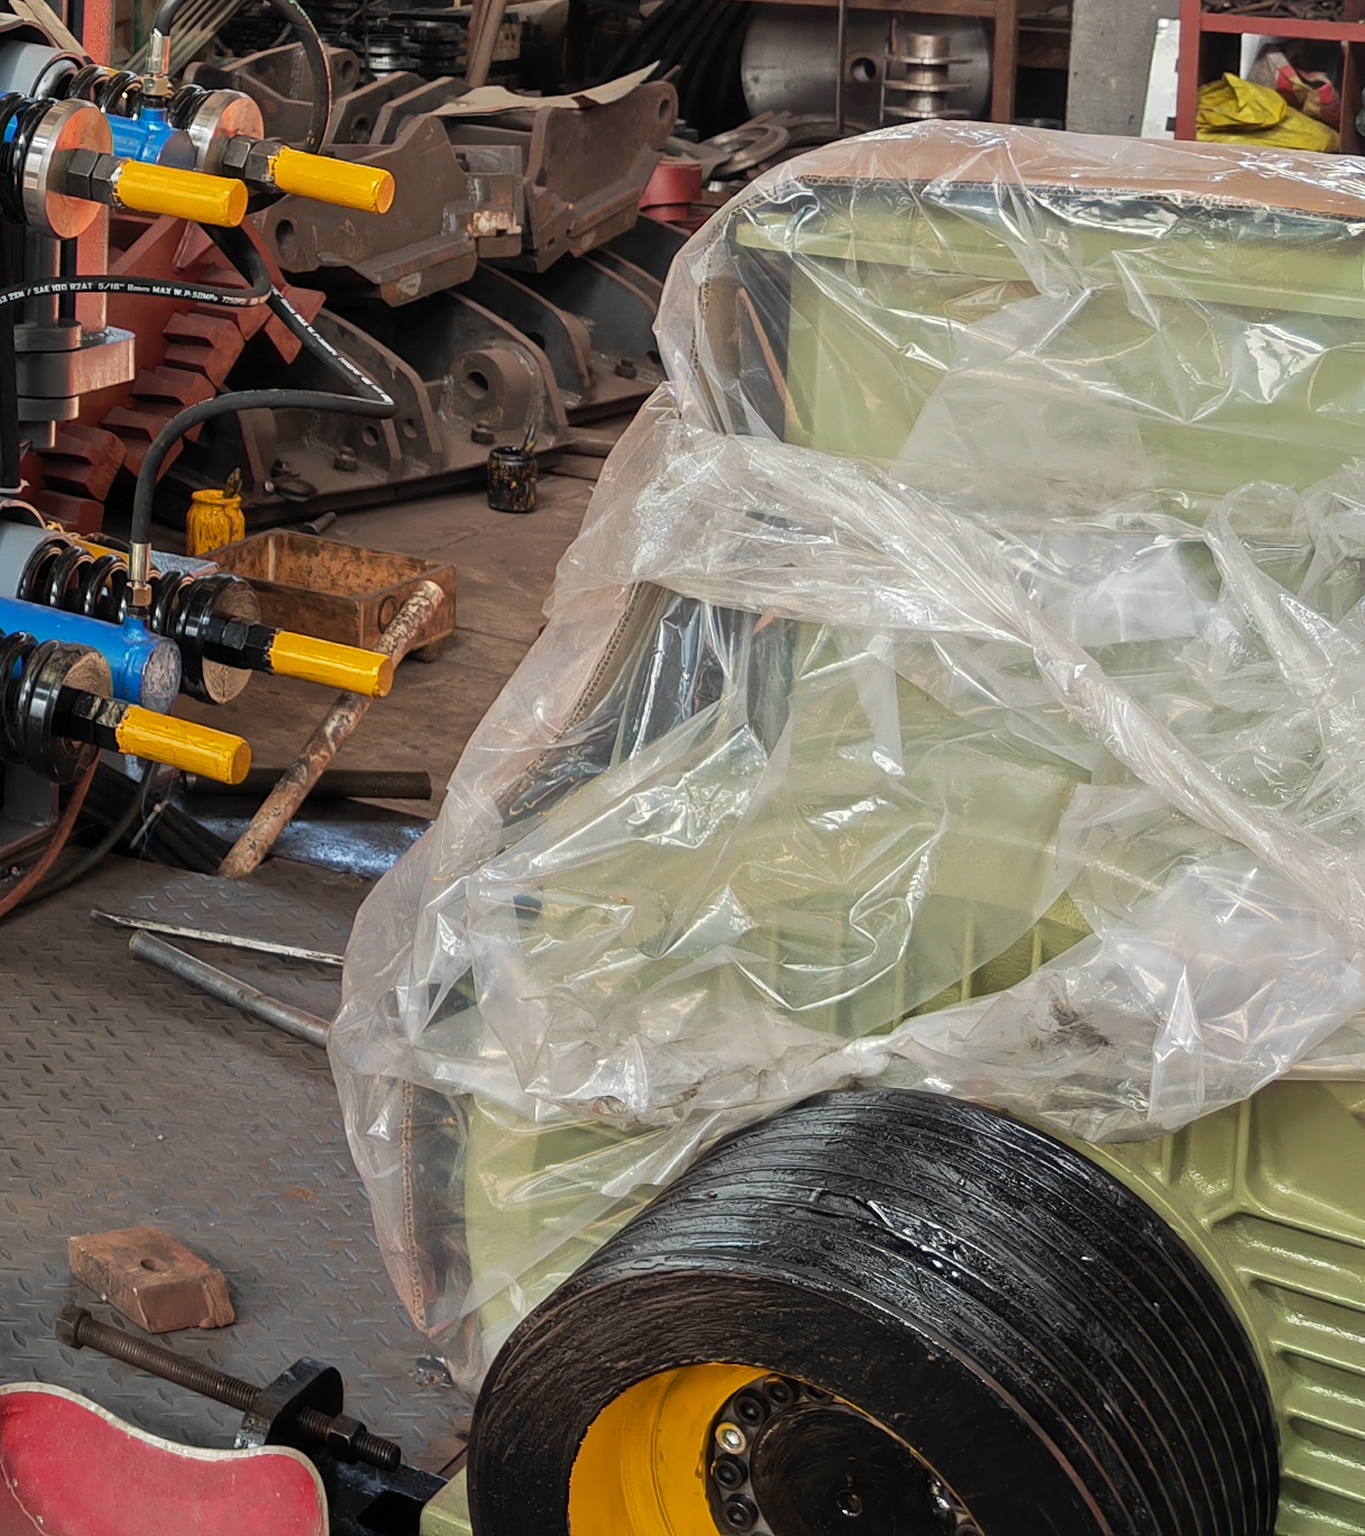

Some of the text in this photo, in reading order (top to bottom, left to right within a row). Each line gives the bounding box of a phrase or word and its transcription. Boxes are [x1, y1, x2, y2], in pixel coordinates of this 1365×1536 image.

[32, 285, 50, 295] SAE
[51, 283, 68, 292] 100
[69, 282, 93, 291] R2AT
[127, 283, 150, 293] 8mm
[152, 286, 172, 295] MAX
